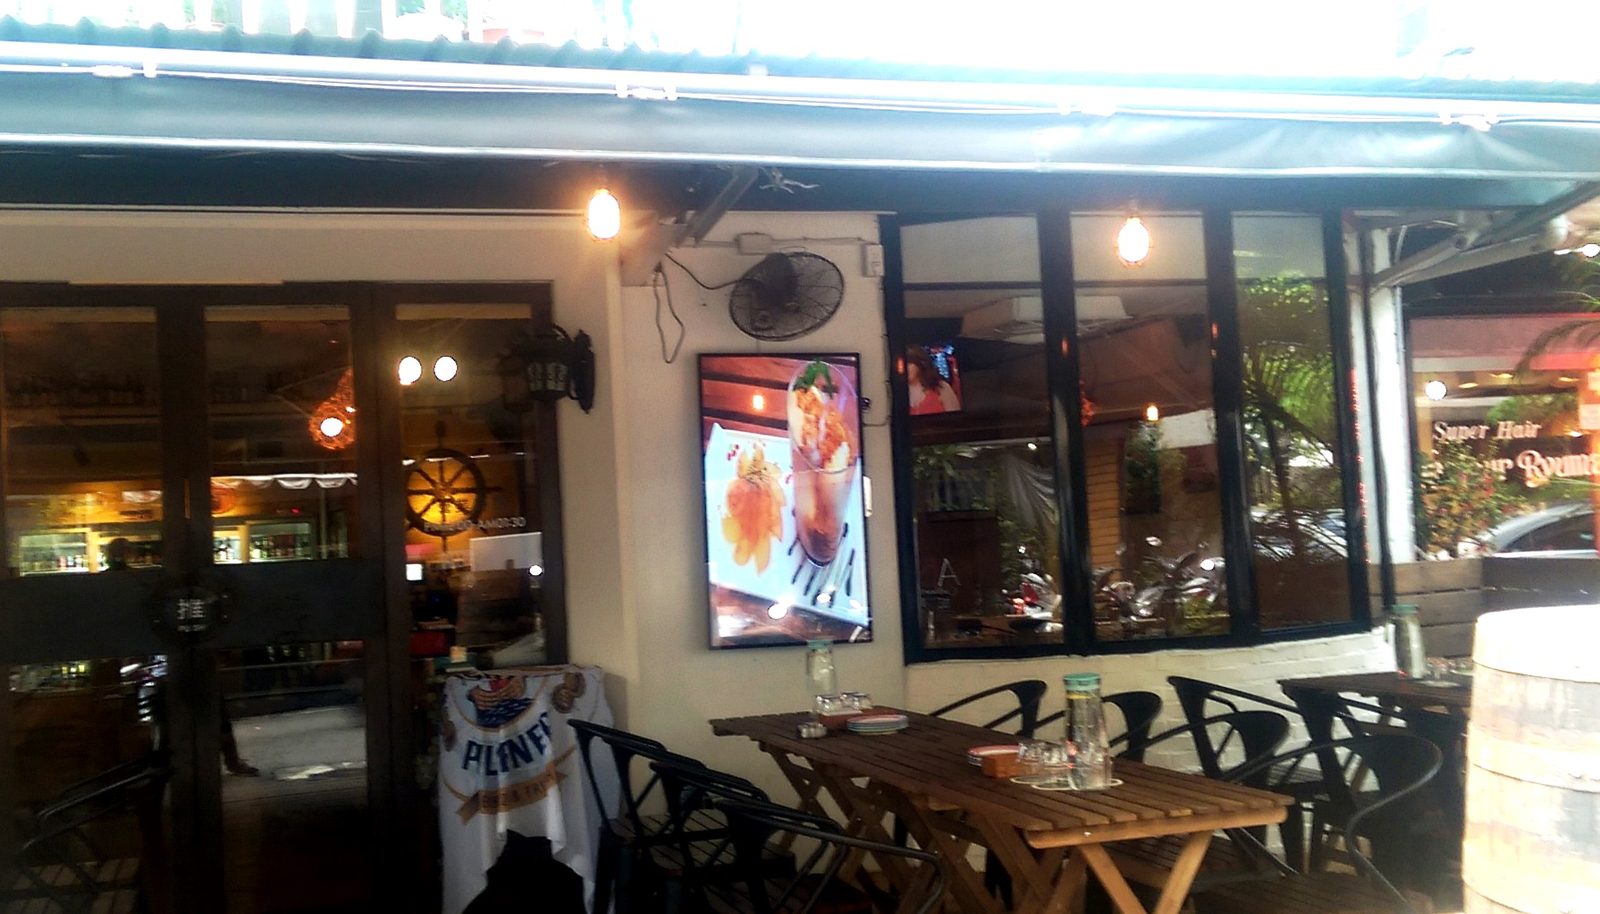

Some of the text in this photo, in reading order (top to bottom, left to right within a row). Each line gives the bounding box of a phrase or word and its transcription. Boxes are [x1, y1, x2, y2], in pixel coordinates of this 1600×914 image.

[1432, 420, 1542, 444] Super Hair
[937, 557, 962, 588] A
